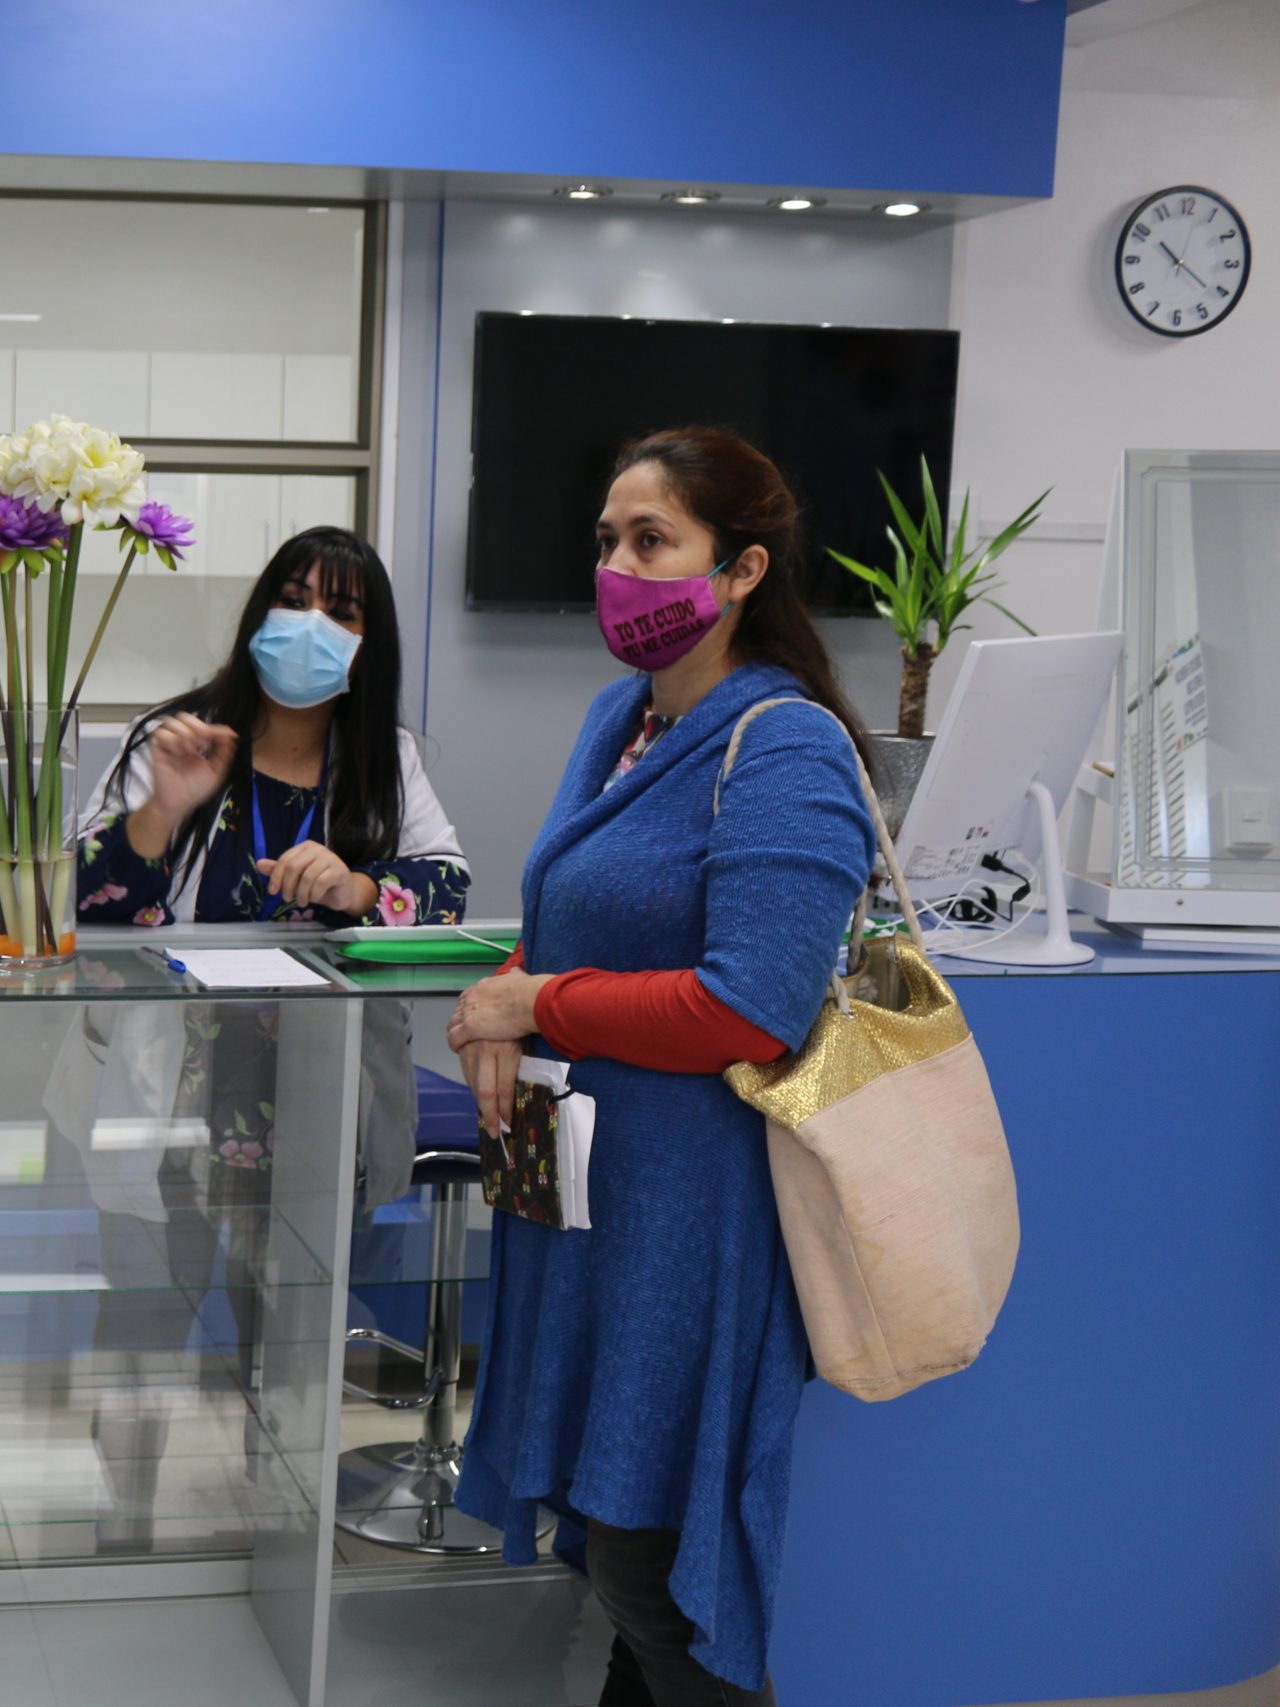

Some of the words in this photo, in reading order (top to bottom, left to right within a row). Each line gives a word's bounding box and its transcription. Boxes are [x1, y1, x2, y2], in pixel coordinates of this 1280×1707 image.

[1154, 203, 1170, 221] 11
[1180, 197, 1196, 216] 12
[1207, 207, 1218, 223] 1
[1131, 223, 1151, 242] 10
[1219, 229, 1236, 243] 2
[1124, 255, 1141, 265] 9
[1224, 259, 1240, 269] 3
[1129, 282, 1145, 295] 8
[1216, 285, 1229, 298] 4
[1147, 301, 1160, 317] 7
[1196, 303, 1209, 320] 5
[1172, 309, 1182, 327] 6
[614, 621, 635, 642] YO
[634, 613, 654, 636] TE
[654, 597, 696, 629] CUIDO
[623, 643, 642, 659] TU
[641, 636, 662, 655] ME
[660, 619, 705, 647] CUIDAS
